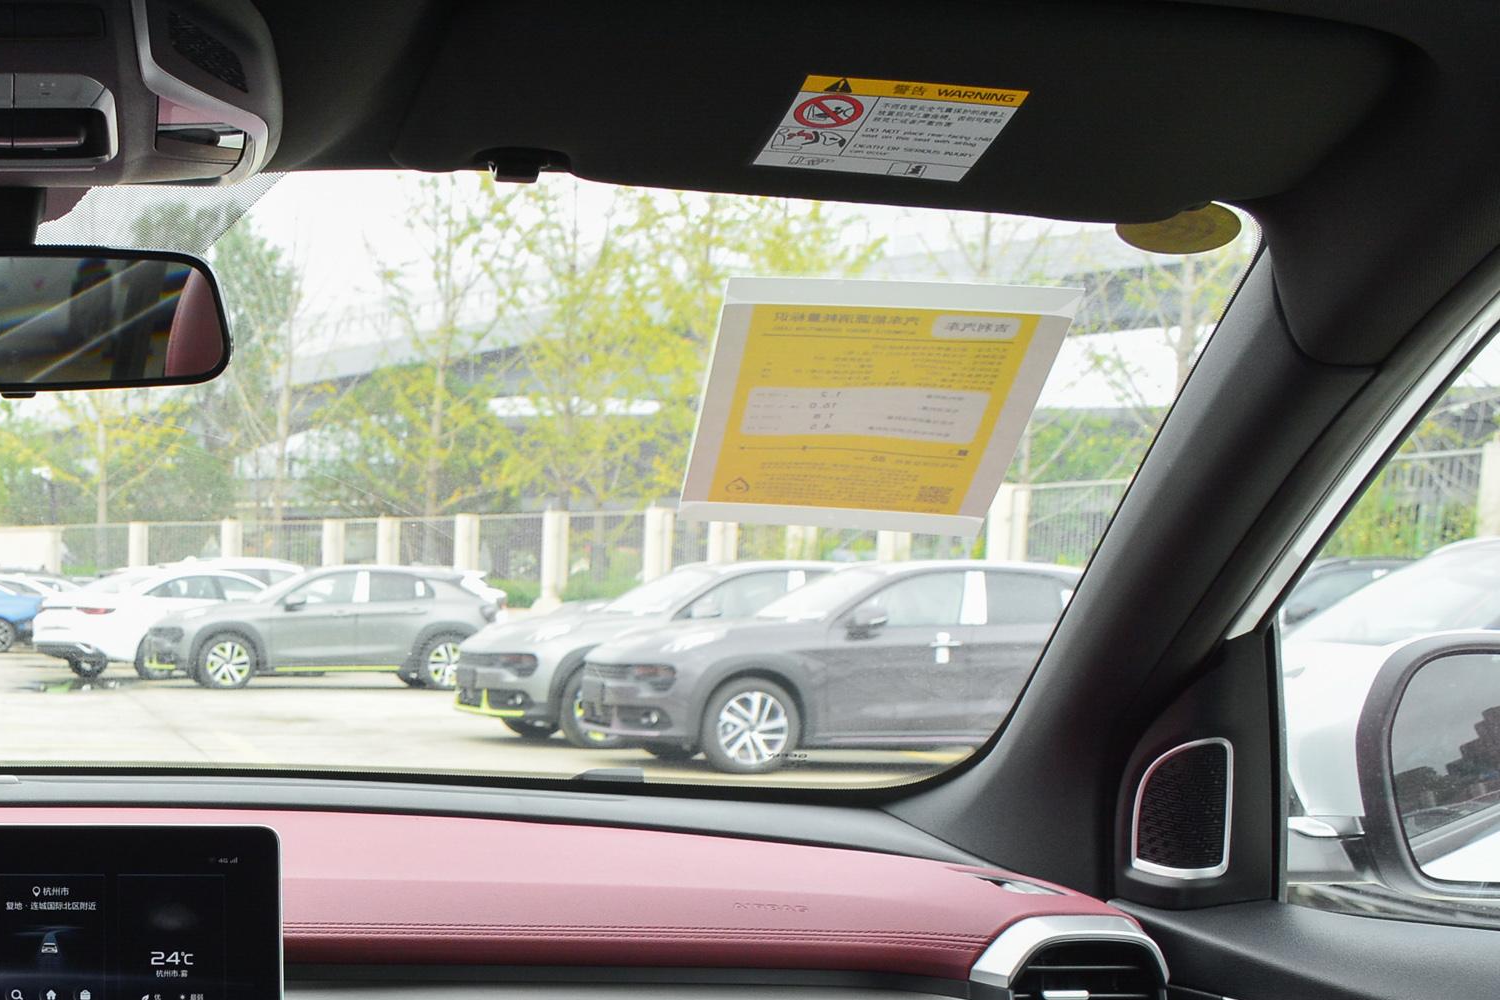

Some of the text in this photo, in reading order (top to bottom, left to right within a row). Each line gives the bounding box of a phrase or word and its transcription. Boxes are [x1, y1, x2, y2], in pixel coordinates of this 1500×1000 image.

[937, 88, 1015, 103] WARNING
[43, 886, 69, 897] 杭州市
[153, 993, 162, 1000] 优
